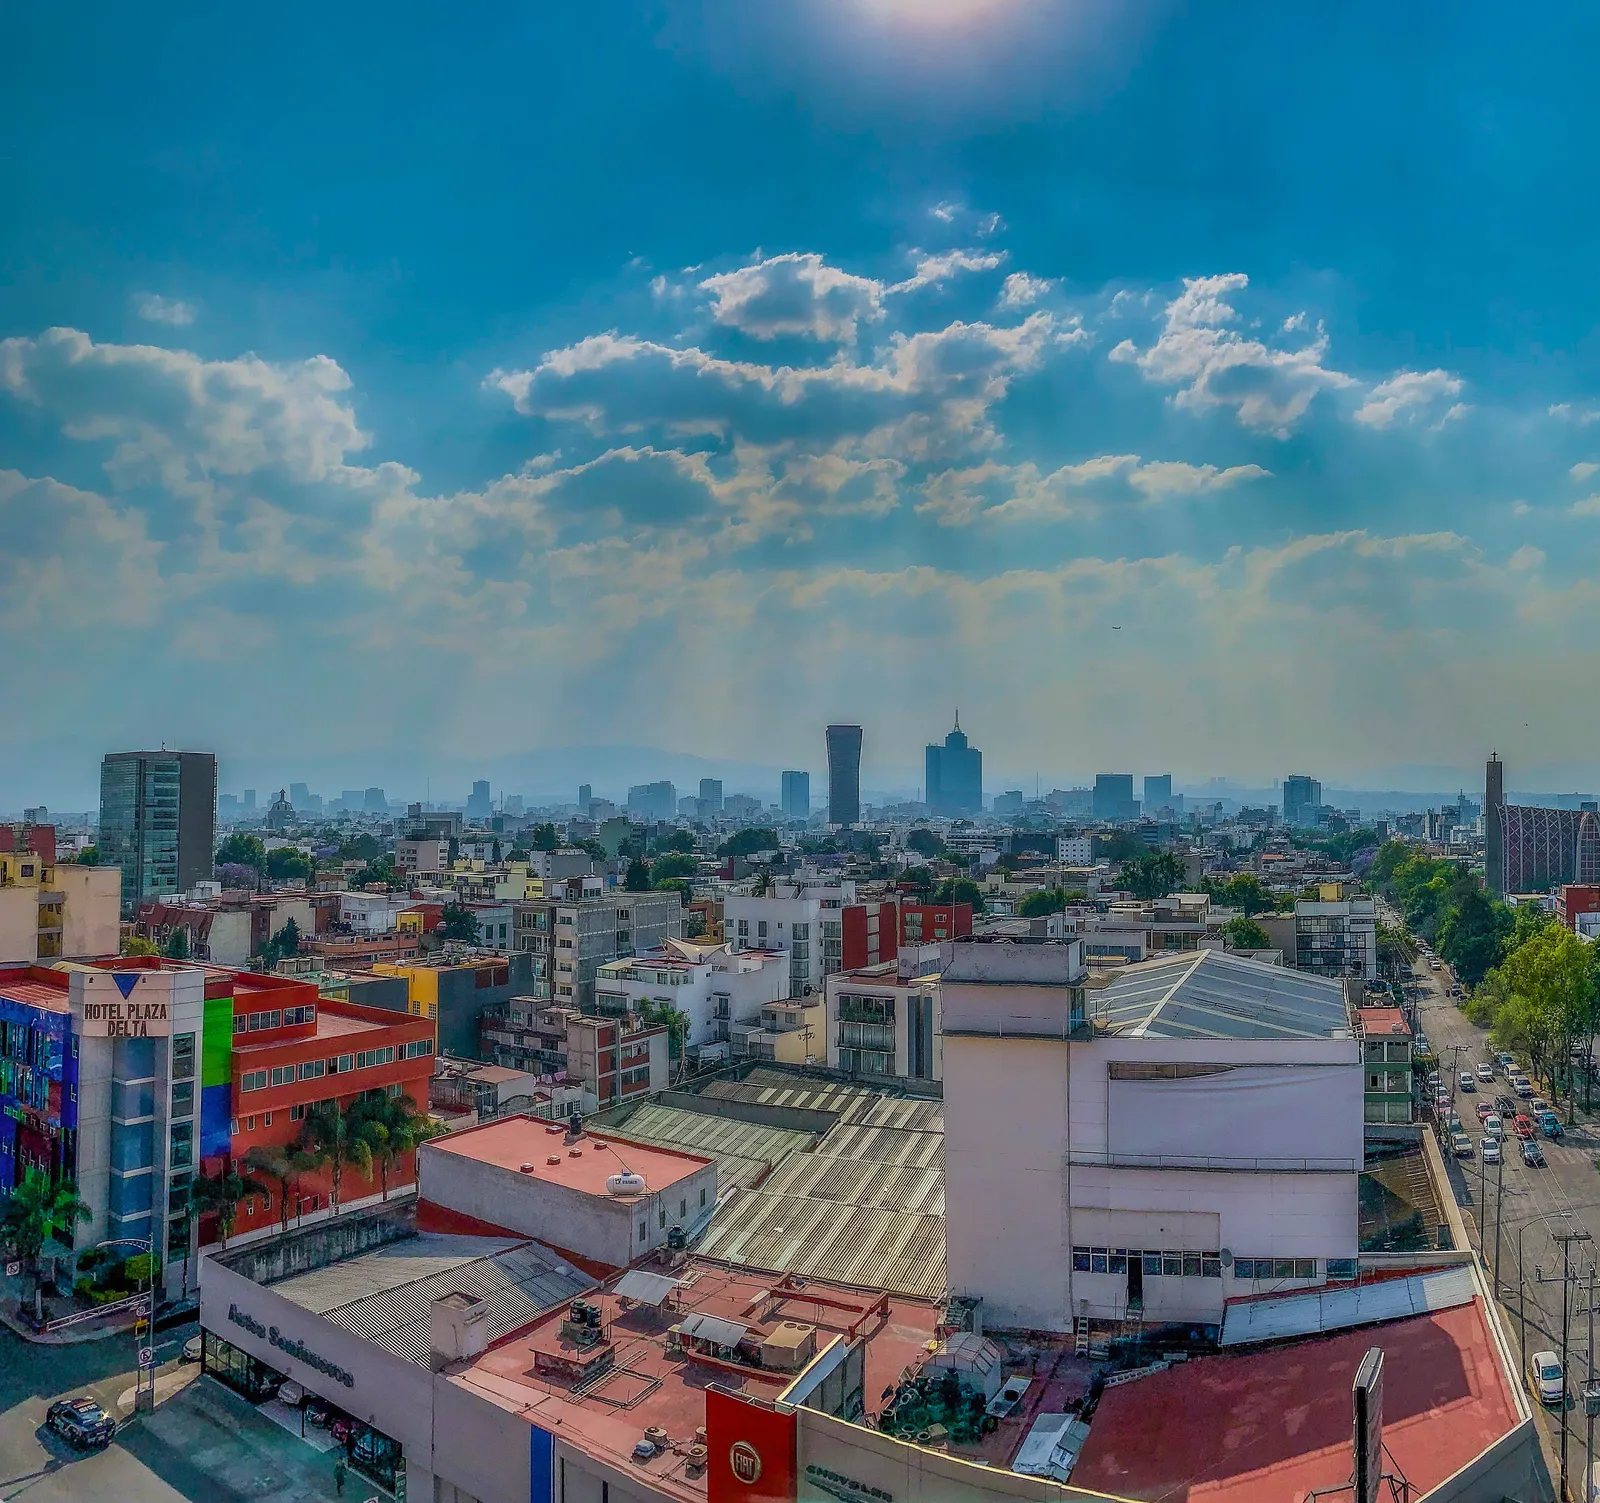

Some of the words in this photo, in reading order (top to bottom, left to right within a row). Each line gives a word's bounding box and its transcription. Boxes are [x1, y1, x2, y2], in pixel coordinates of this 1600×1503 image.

[84, 1003, 124, 1020] HOTEL
[128, 1003, 167, 1020] PLAZA
[107, 1021, 147, 1036] DELTA
[228, 1303, 266, 1339] Autos
[735, 1452, 755, 1476] FIAT
